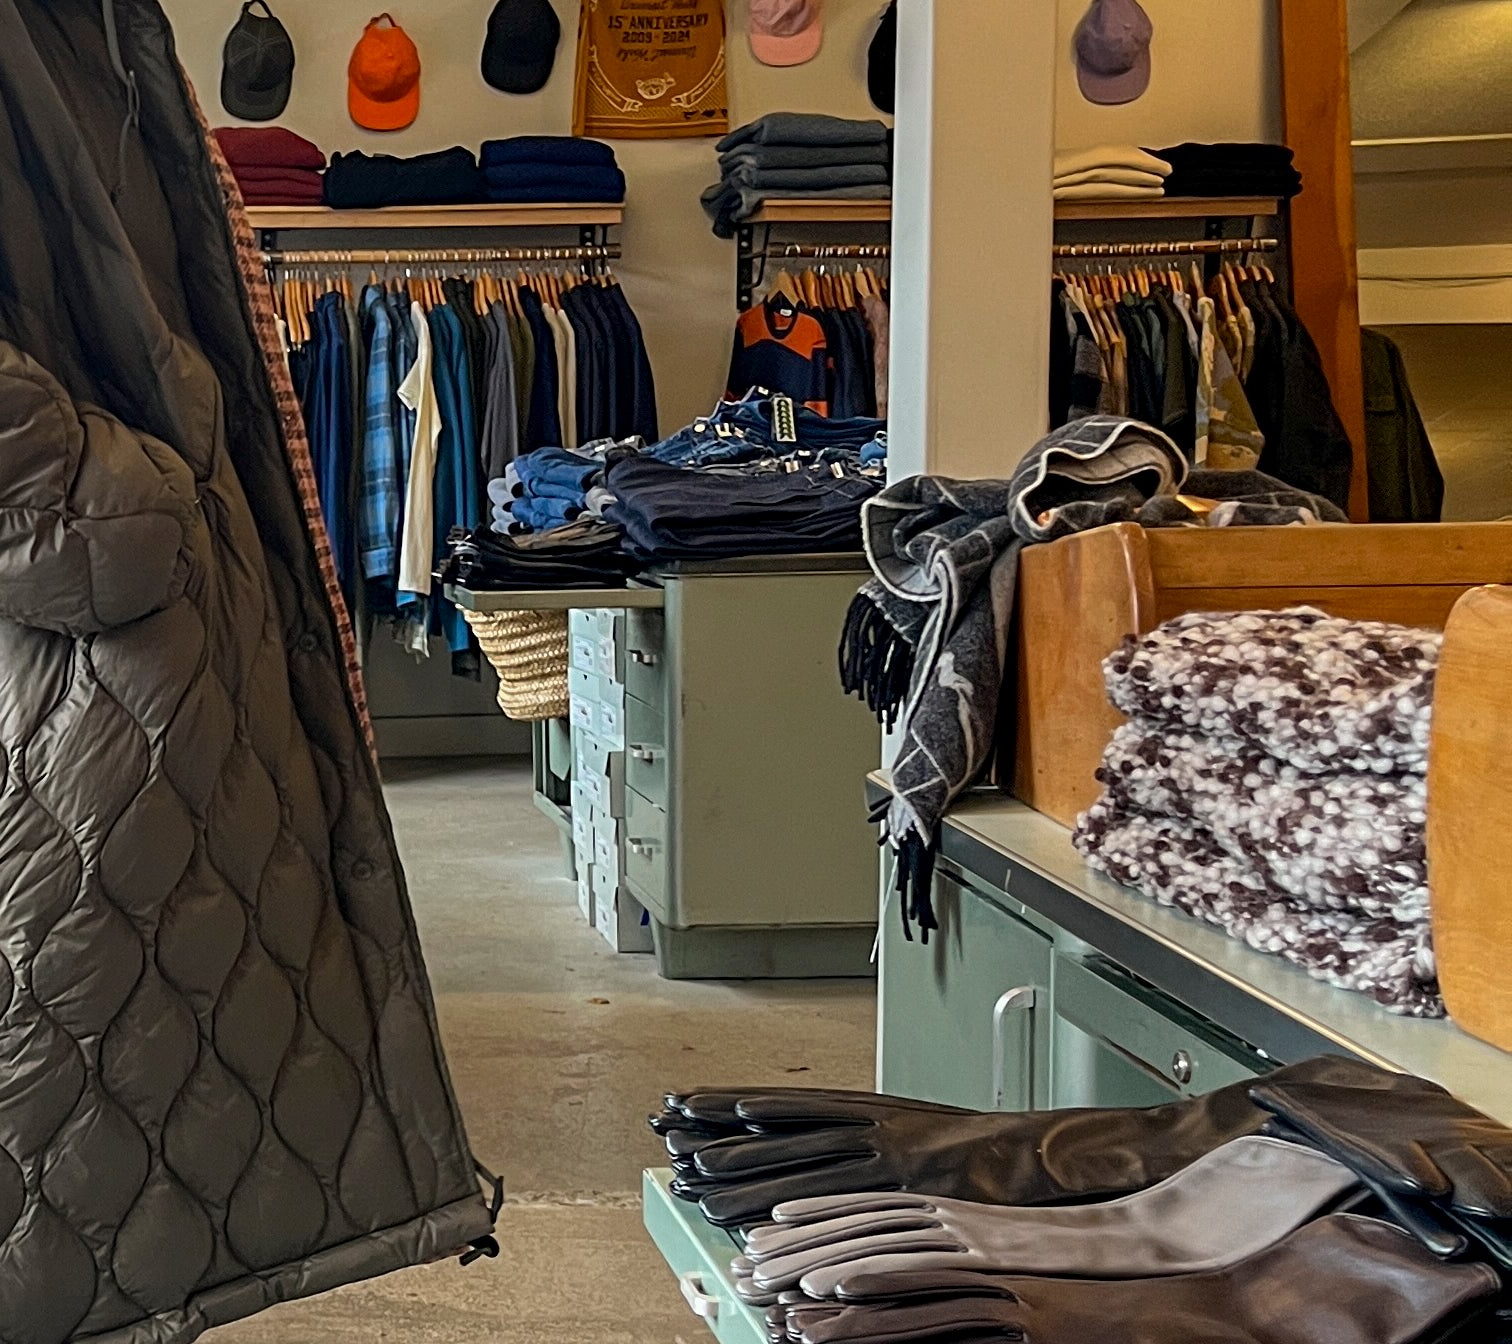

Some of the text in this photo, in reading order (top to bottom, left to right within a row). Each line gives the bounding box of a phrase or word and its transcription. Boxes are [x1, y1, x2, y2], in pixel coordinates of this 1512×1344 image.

[629, 13, 708, 30] ANNIVERSARY
[622, 31, 653, 44] 2009
[663, 29, 691, 44] 2024
